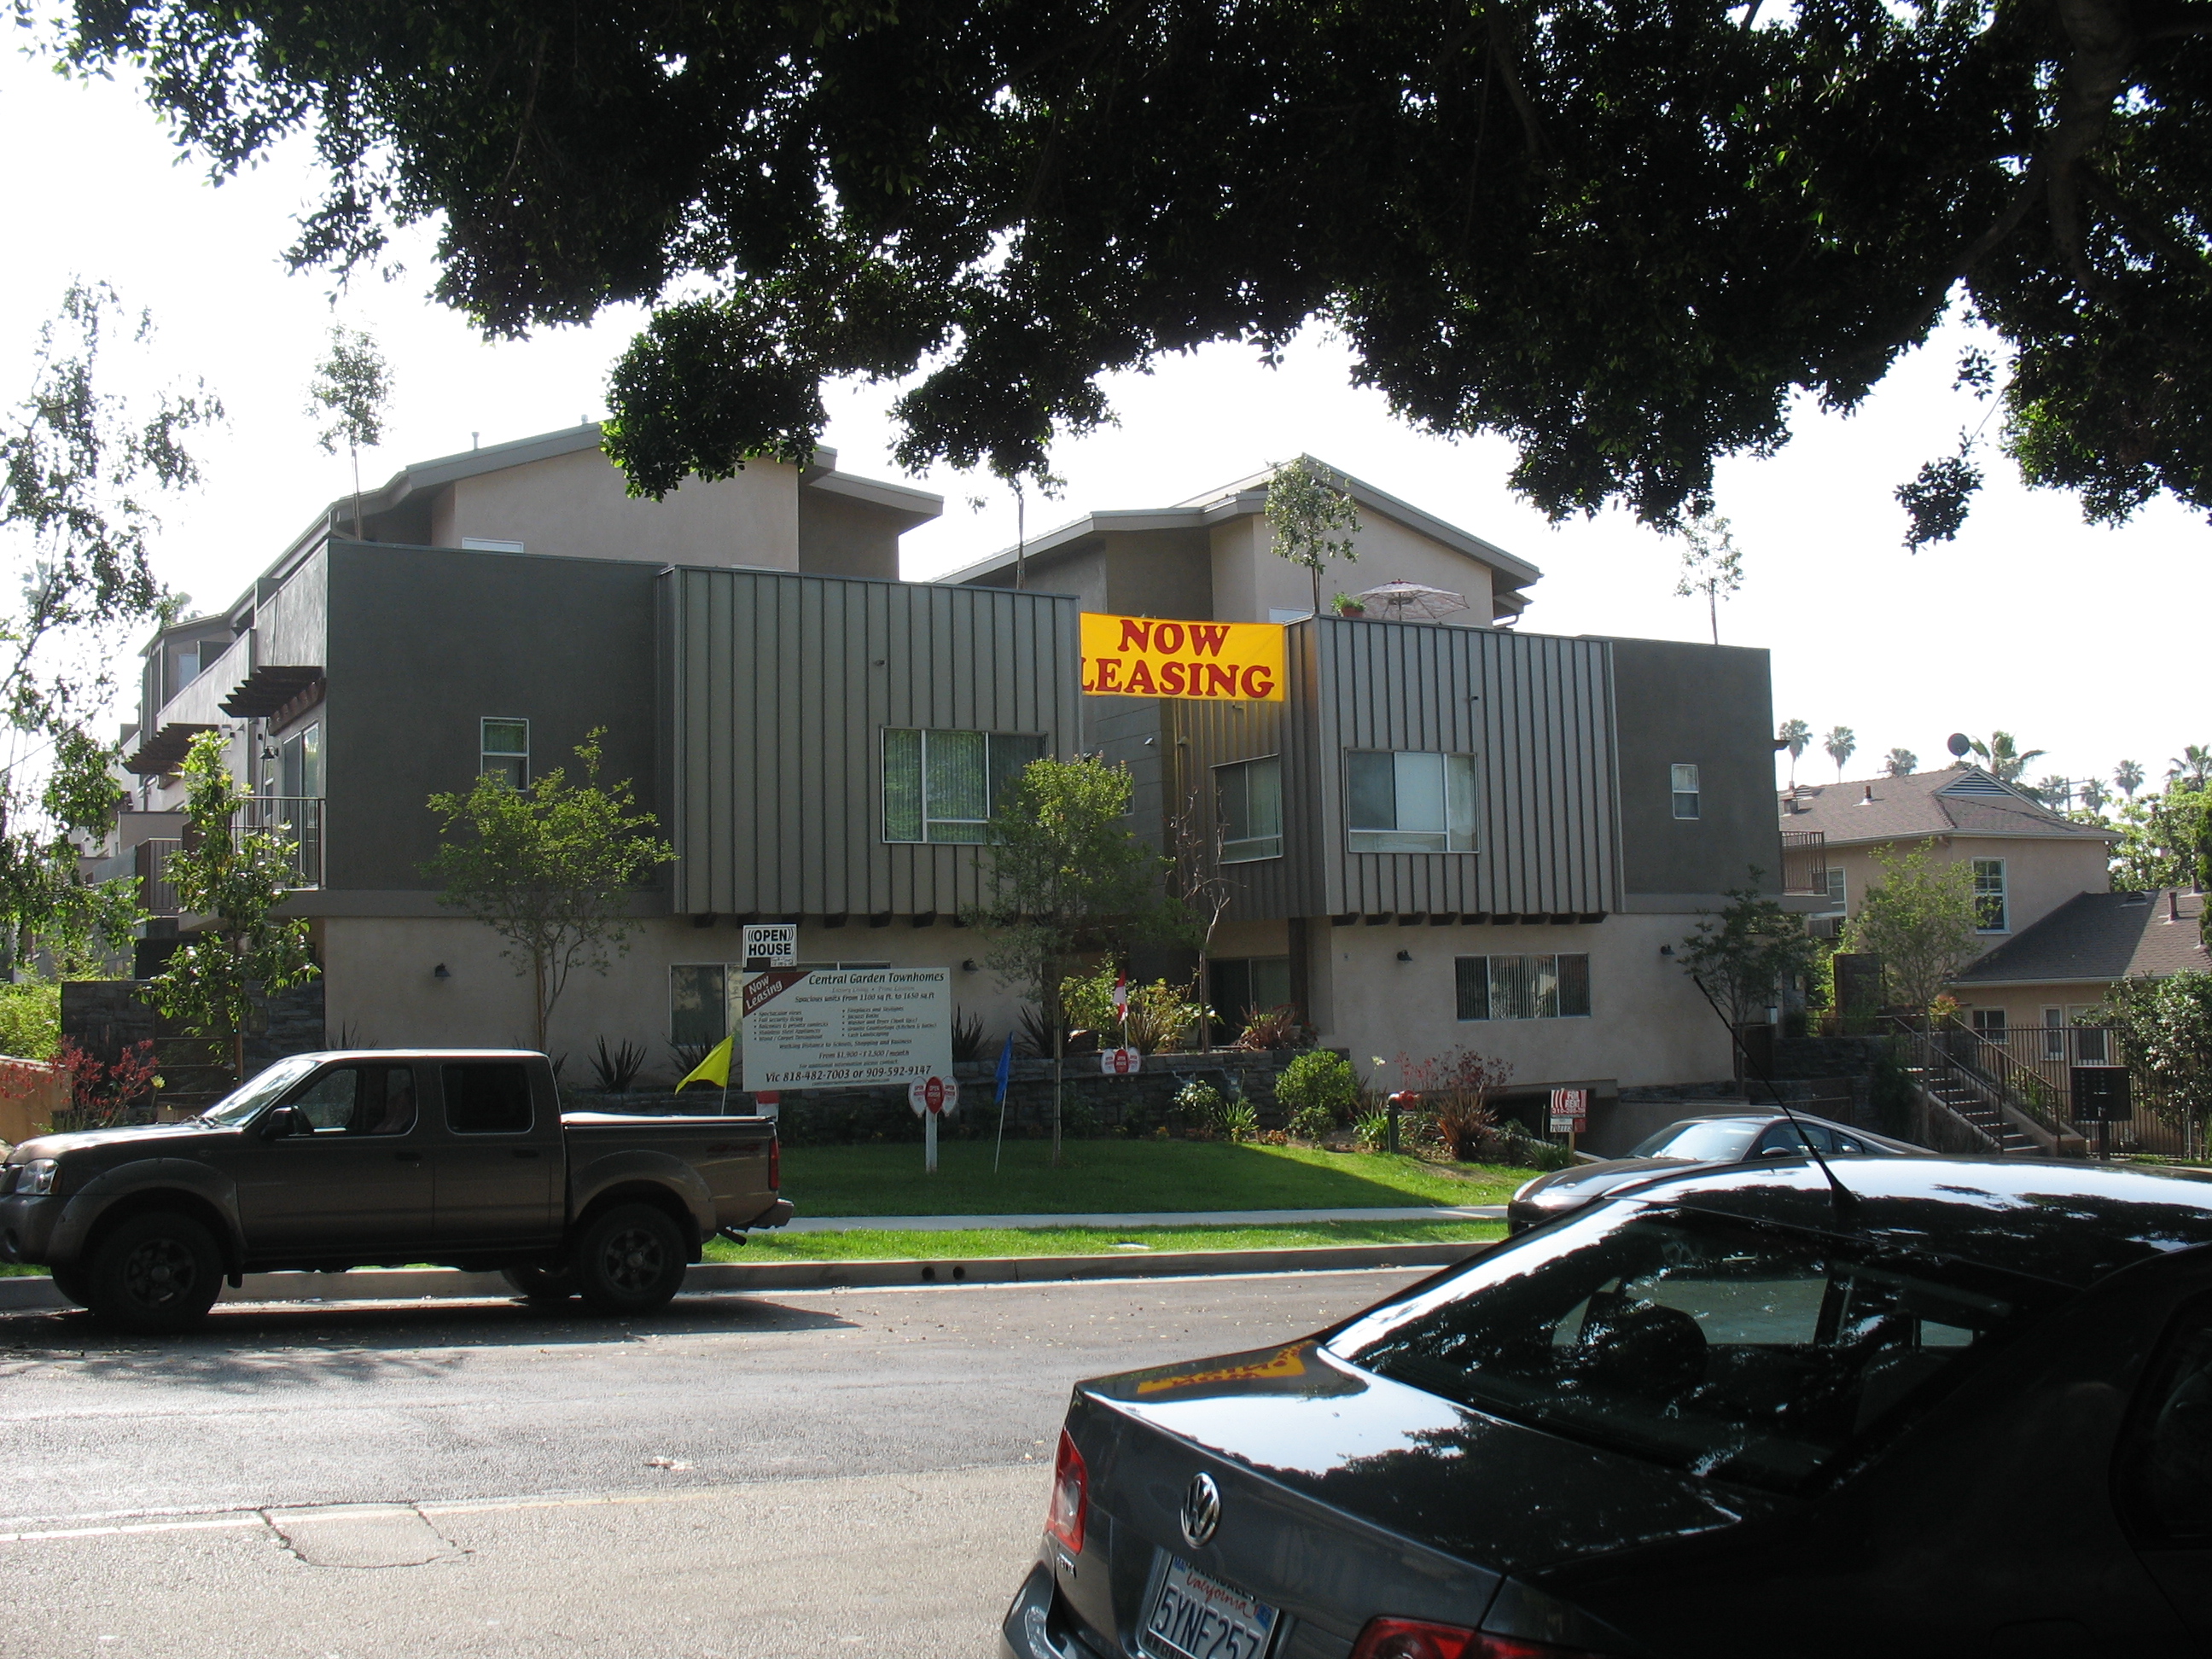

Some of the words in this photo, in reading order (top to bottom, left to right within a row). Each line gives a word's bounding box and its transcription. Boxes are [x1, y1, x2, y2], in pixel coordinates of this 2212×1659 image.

[1117, 620, 1231, 657] NOW
[1081, 657, 1274, 698] LEASING
[754, 929, 787, 942] OPEN
[748, 943, 791, 956] HOUSE
[748, 975, 770, 995] Now
[809, 974, 847, 985] Central
[850, 973, 886, 984] Garden
[888, 972, 944, 983] Townhomes
[746, 981, 783, 1010] Leasing
[795, 995, 823, 1004] Spacious
[766, 1072, 780, 1082] Vic
[783, 1069, 850, 1081] 818-482-7003
[853, 1069, 864, 1078] or
[866, 1065, 931, 1077] 909-592-9147
[1565, 1099, 1580, 1108] RENT
[1567, 1091, 1579, 1099] FOR
[1186, 1572, 1260, 1619] California
[1156, 1583, 1263, 1659] 5YNF257
